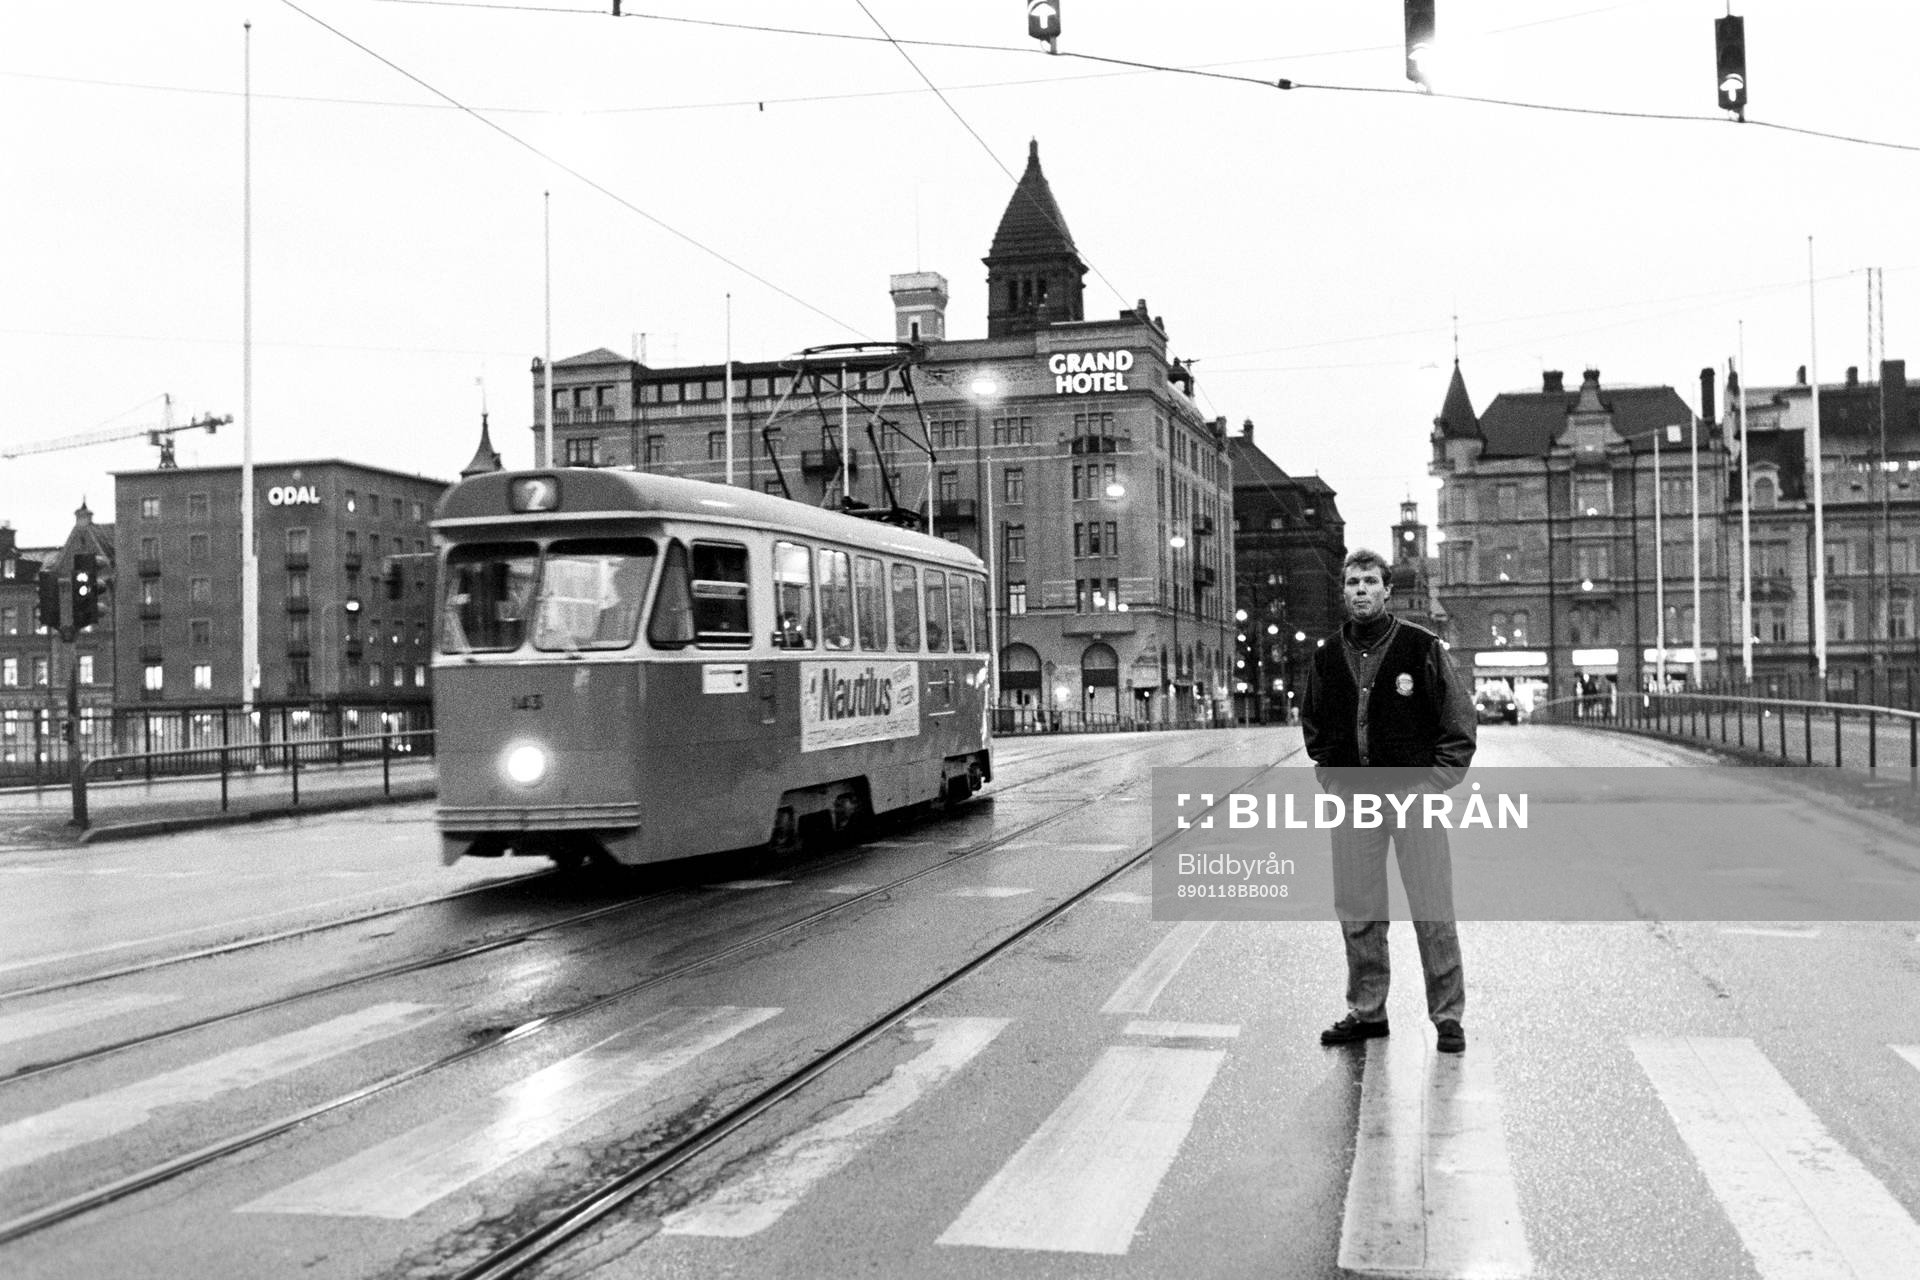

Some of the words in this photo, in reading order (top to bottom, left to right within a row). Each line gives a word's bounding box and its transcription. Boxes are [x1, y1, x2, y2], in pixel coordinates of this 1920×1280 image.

[1049, 350, 1134, 374] GRAND
[1056, 372, 1129, 394] HOTEL
[268, 486, 321, 506] ODAL
[524, 480, 547, 511] 2
[820, 667, 893, 721] Nautilus
